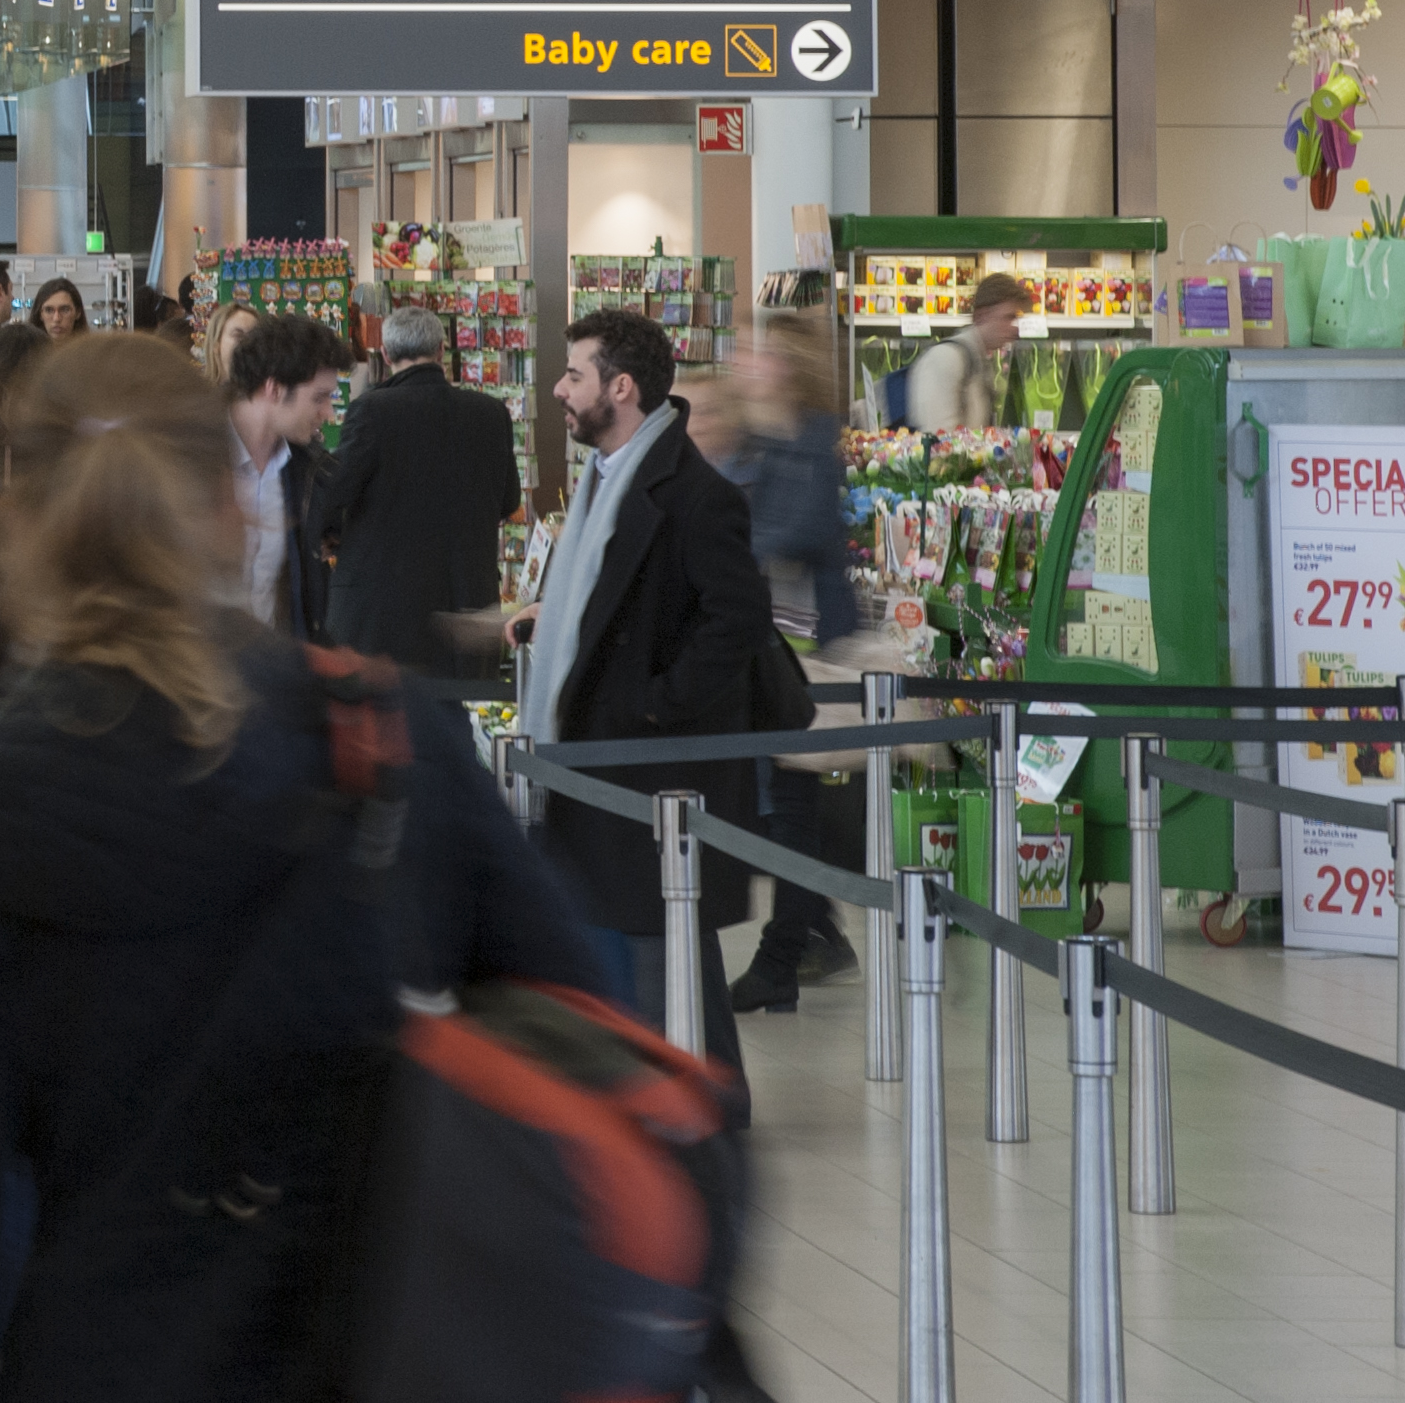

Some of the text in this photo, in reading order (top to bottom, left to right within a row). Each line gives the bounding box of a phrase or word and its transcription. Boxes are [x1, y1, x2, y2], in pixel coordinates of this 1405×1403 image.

[524, 31, 712, 73] Baby care
[453, 223, 491, 234] Groente
[466, 243, 516, 256] Potagères
[1315, 487, 1405, 517] OFFER
[1308, 650, 1345, 664] TULIPS
[1346, 671, 1384, 684] TULIPS
